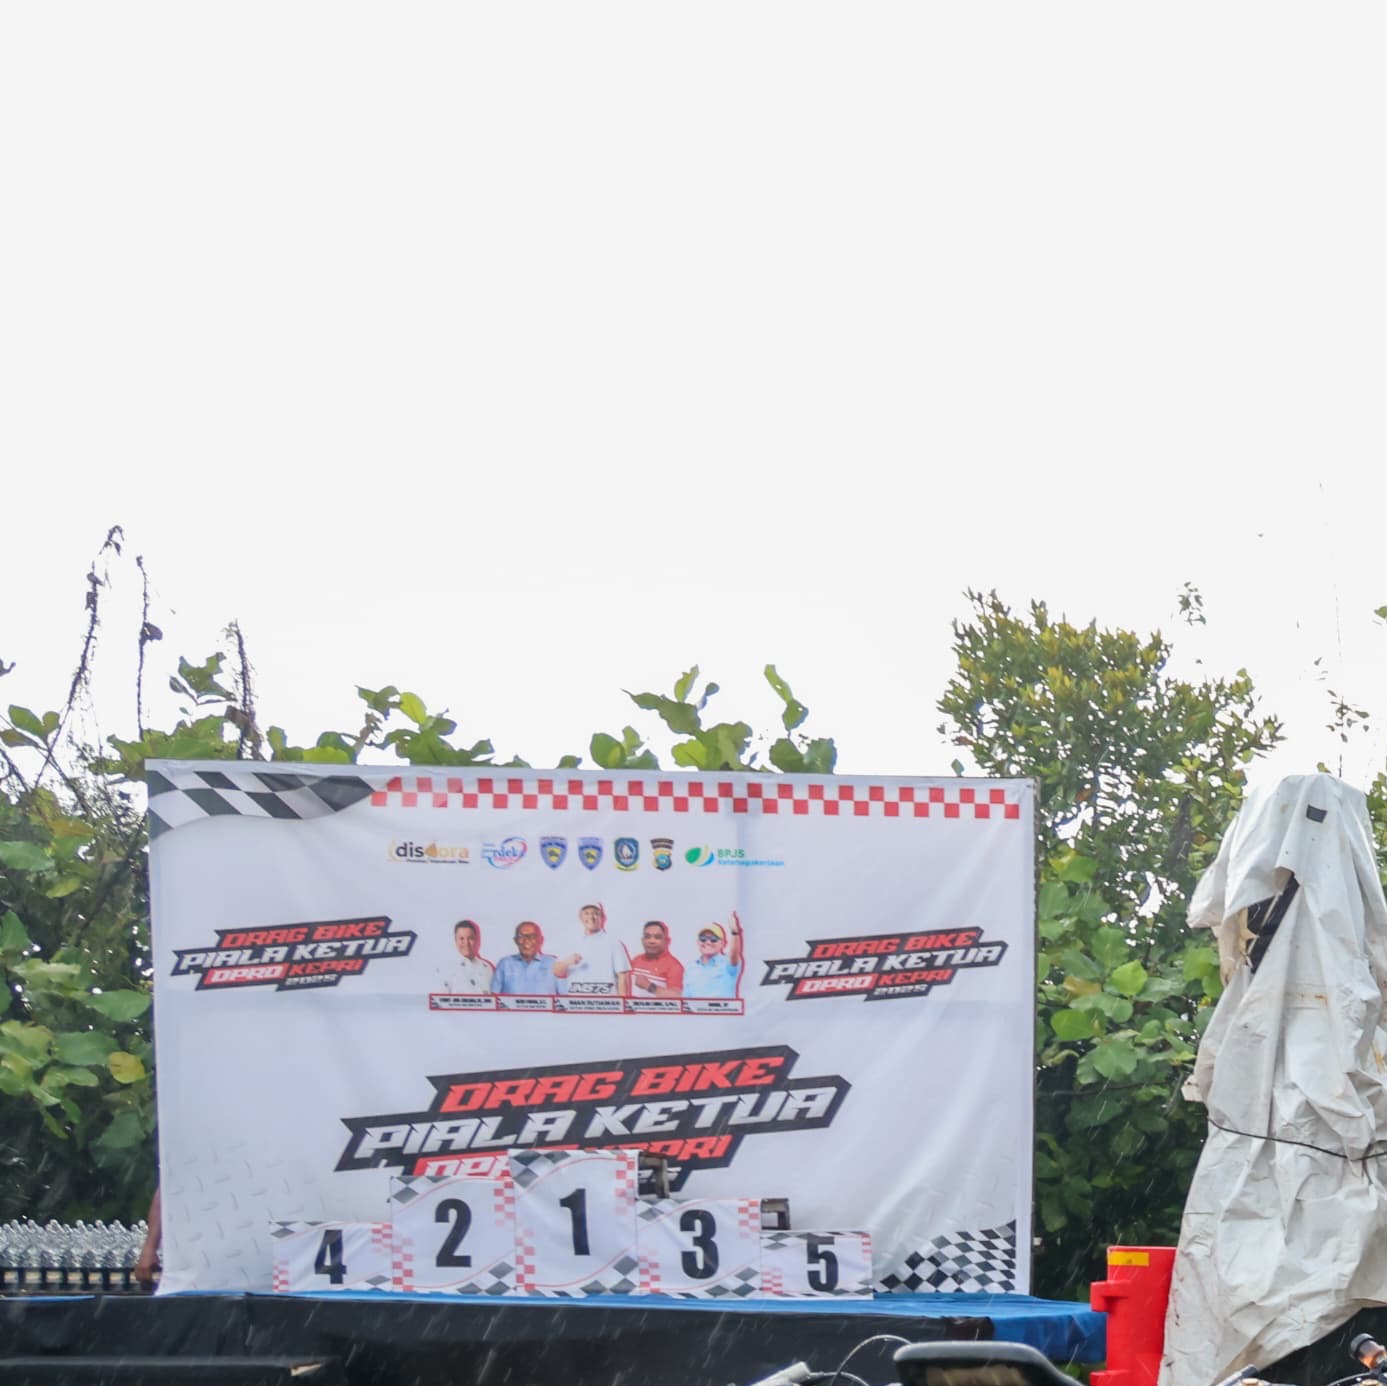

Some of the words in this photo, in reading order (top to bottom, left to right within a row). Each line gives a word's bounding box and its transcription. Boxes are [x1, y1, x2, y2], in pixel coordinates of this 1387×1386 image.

[179, 945, 289, 970] PIALA
[293, 935, 412, 960] KETUA
[219, 927, 309, 948] DRAG
[312, 921, 386, 940] BIKE
[769, 955, 879, 980] PIALA
[881, 945, 1002, 970] KETUA
[811, 938, 901, 958] DRAG
[904, 931, 977, 951] BIKE
[288, 959, 364, 976] KEPRI
[878, 969, 953, 986] KEPRI
[439, 1069, 624, 1113] DRAG
[629, 1056, 784, 1097] BIKE
[353, 1109, 577, 1159] PIALA
[584, 1086, 838, 1139] KETUA
[434, 1198, 472, 1268] 2
[559, 1188, 591, 1256] 1
[679, 1209, 720, 1280] 3
[314, 1229, 347, 1285] 4
[806, 1235, 840, 1292] 5
